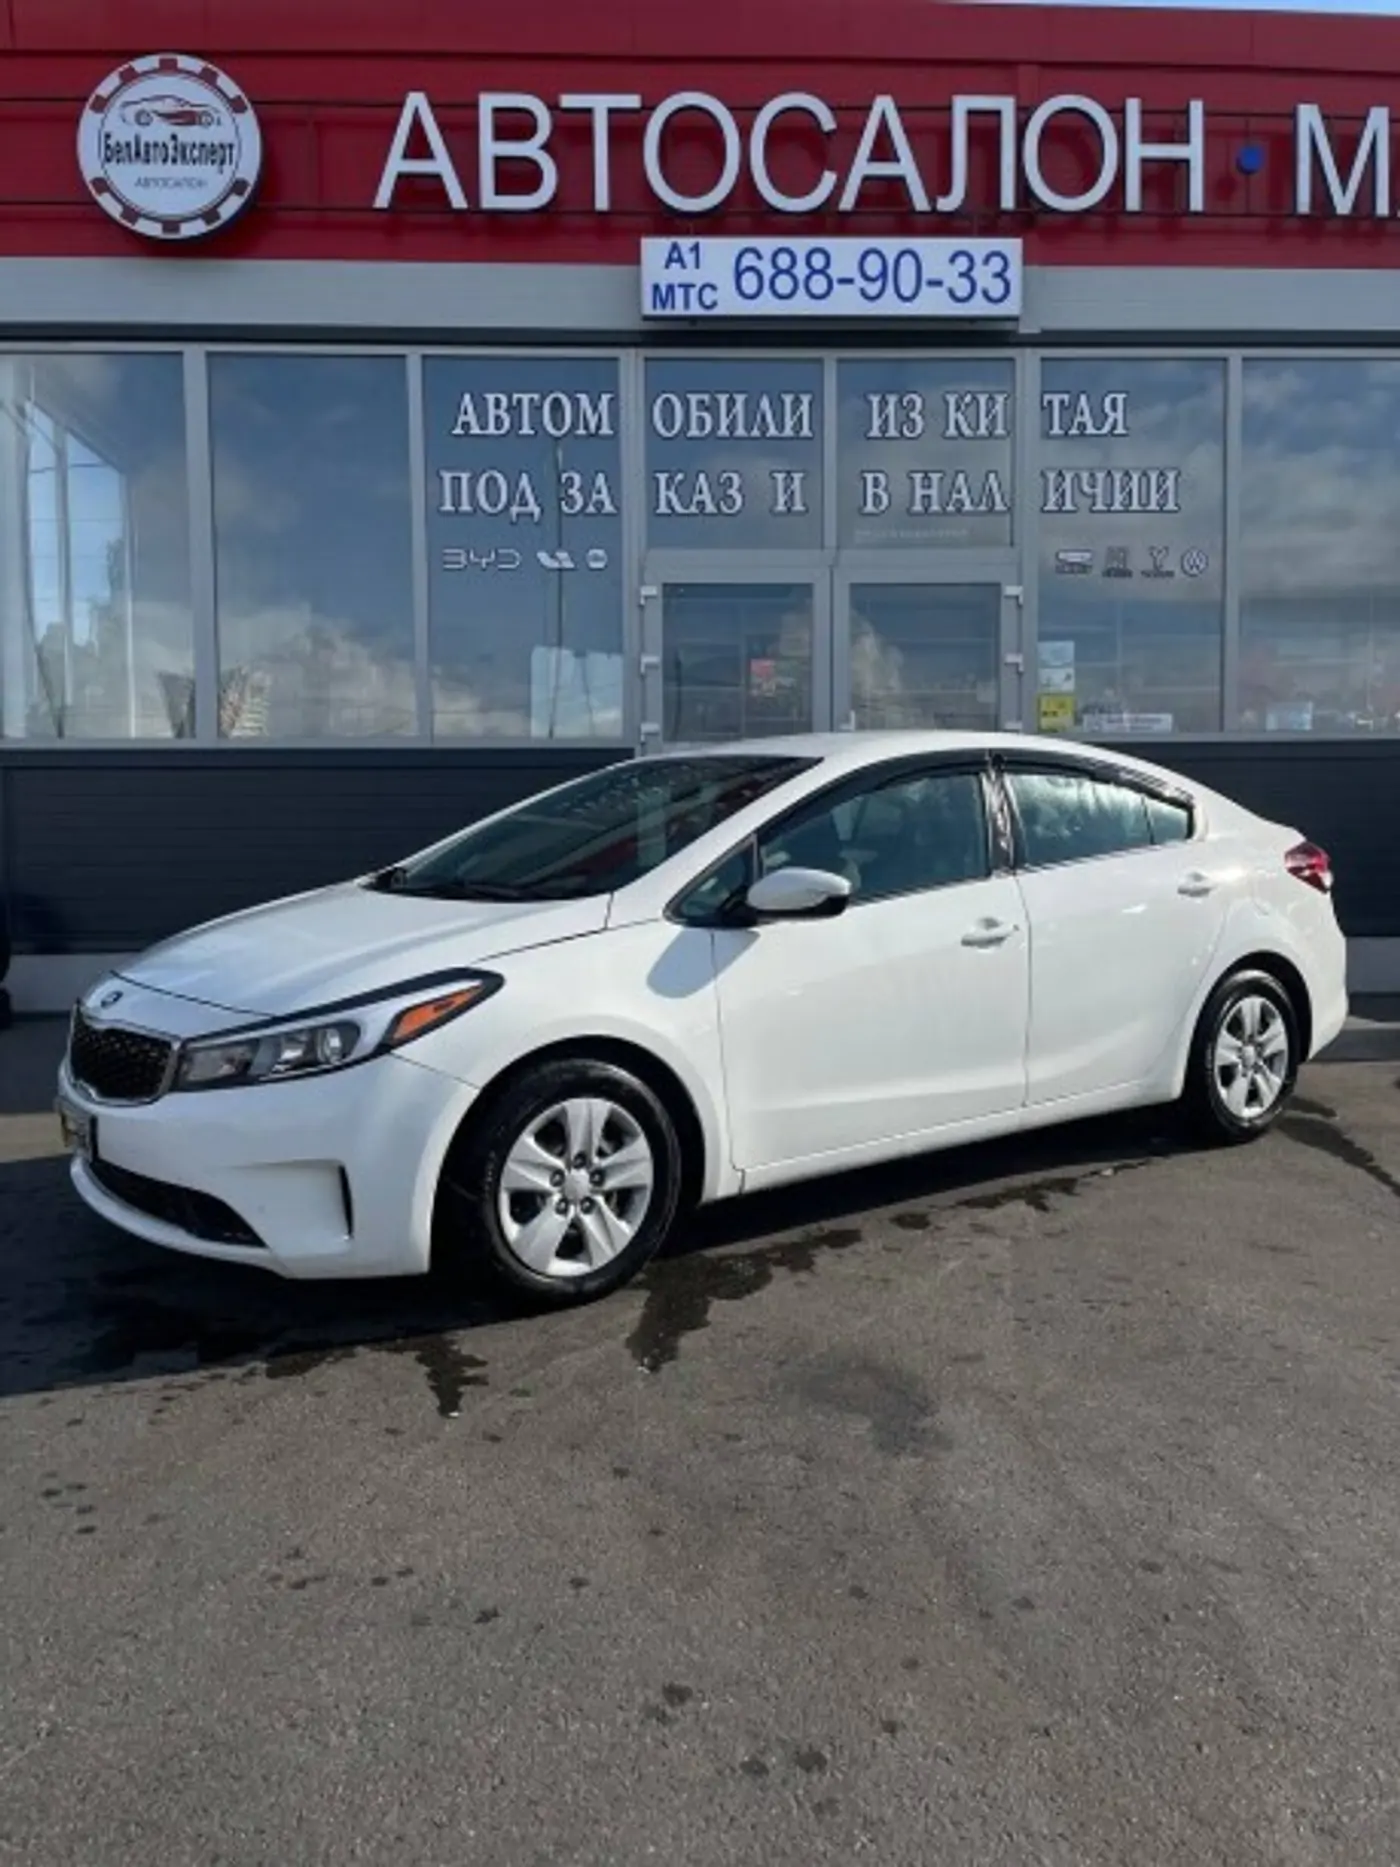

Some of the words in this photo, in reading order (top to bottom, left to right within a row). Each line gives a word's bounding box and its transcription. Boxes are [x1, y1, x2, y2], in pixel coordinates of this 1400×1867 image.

[373, 91, 1205, 214] АВТОСАЛОН
[1296, 103, 1400, 218] М
[651, 282, 718, 312] МТС
[733, 246, 1013, 304] 688-90-33
[867, 393, 925, 439] ИЗ
[439, 469, 543, 523] ПОД
[774, 472, 808, 513] И
[860, 471, 890, 515] В
[443, 548, 522, 570] BYD
